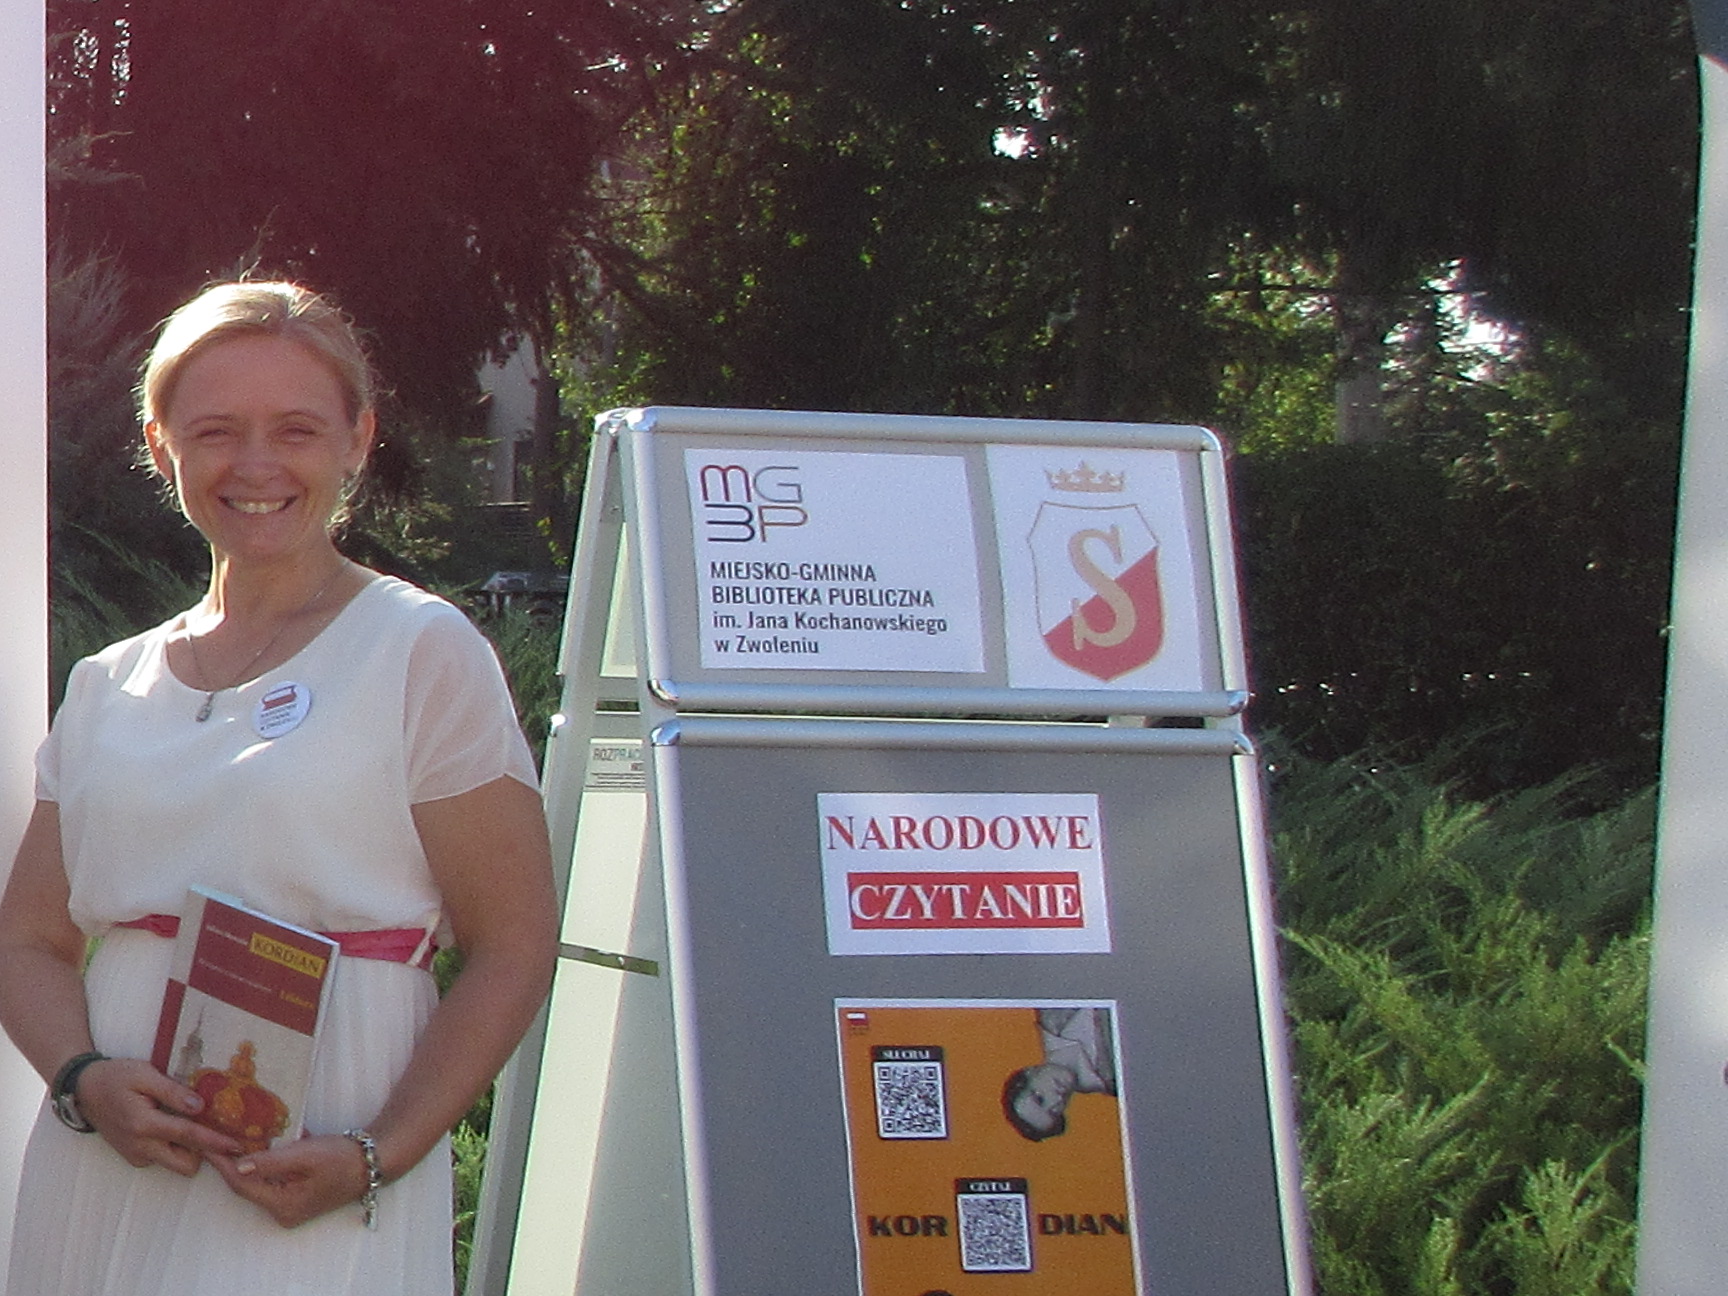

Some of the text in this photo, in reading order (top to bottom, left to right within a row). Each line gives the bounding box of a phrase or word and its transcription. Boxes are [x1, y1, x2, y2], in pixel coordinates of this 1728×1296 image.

[710, 561, 877, 582] MIEJSKO-GMINNA
[712, 586, 934, 607] BIBLIOTEKA PUBLICZNA
[713, 612, 947, 634] im. Jana Kochanowskiego
[715, 636, 819, 654] w Zwoleniu
[827, 813, 1093, 853] NARODOWE
[849, 881, 1080, 922] CZYTANIE
[254, 941, 319, 973] KORDIAN
[869, 1213, 1130, 1239] KOR DIAN
